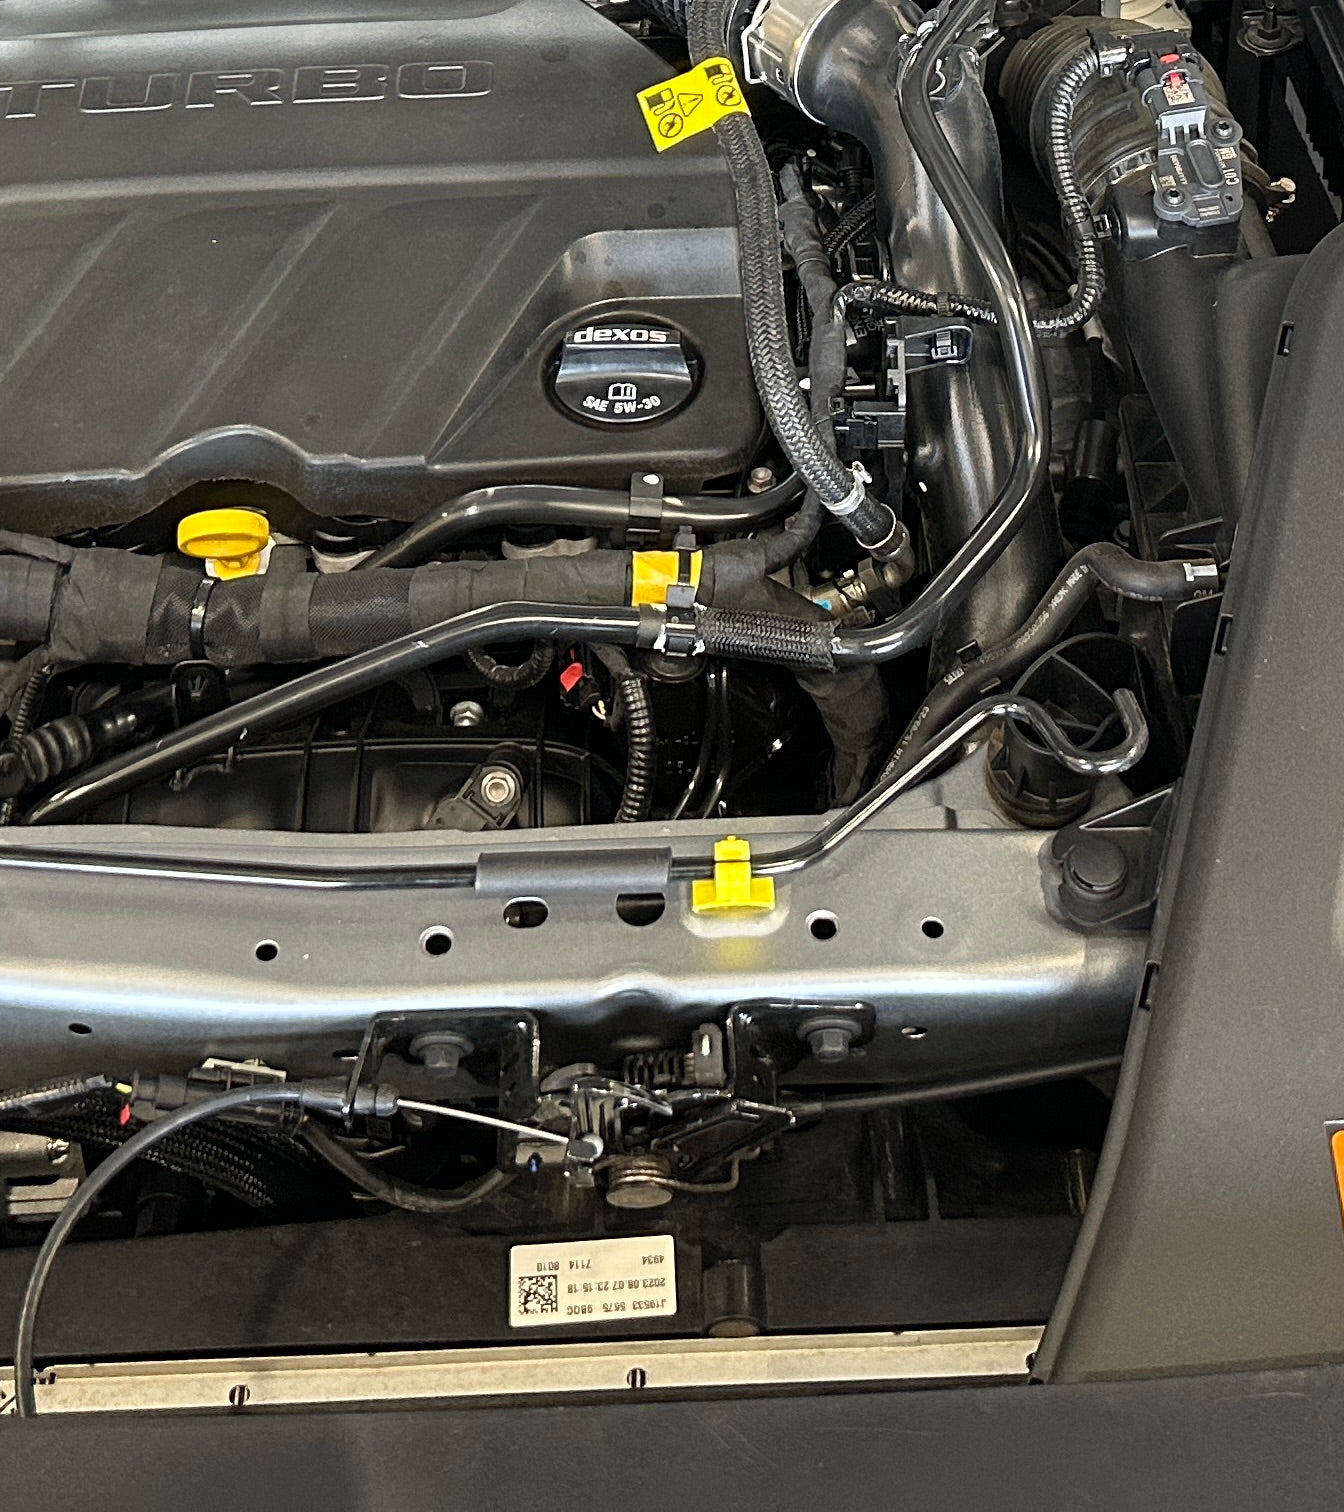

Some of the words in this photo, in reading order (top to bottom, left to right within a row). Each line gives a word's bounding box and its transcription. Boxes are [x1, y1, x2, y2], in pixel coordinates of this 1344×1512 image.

[573, 326, 668, 343] dexos
[582, 395, 609, 412] SAE
[613, 395, 661, 414] 5W-30
[569, 1259, 591, 1270] 7114
